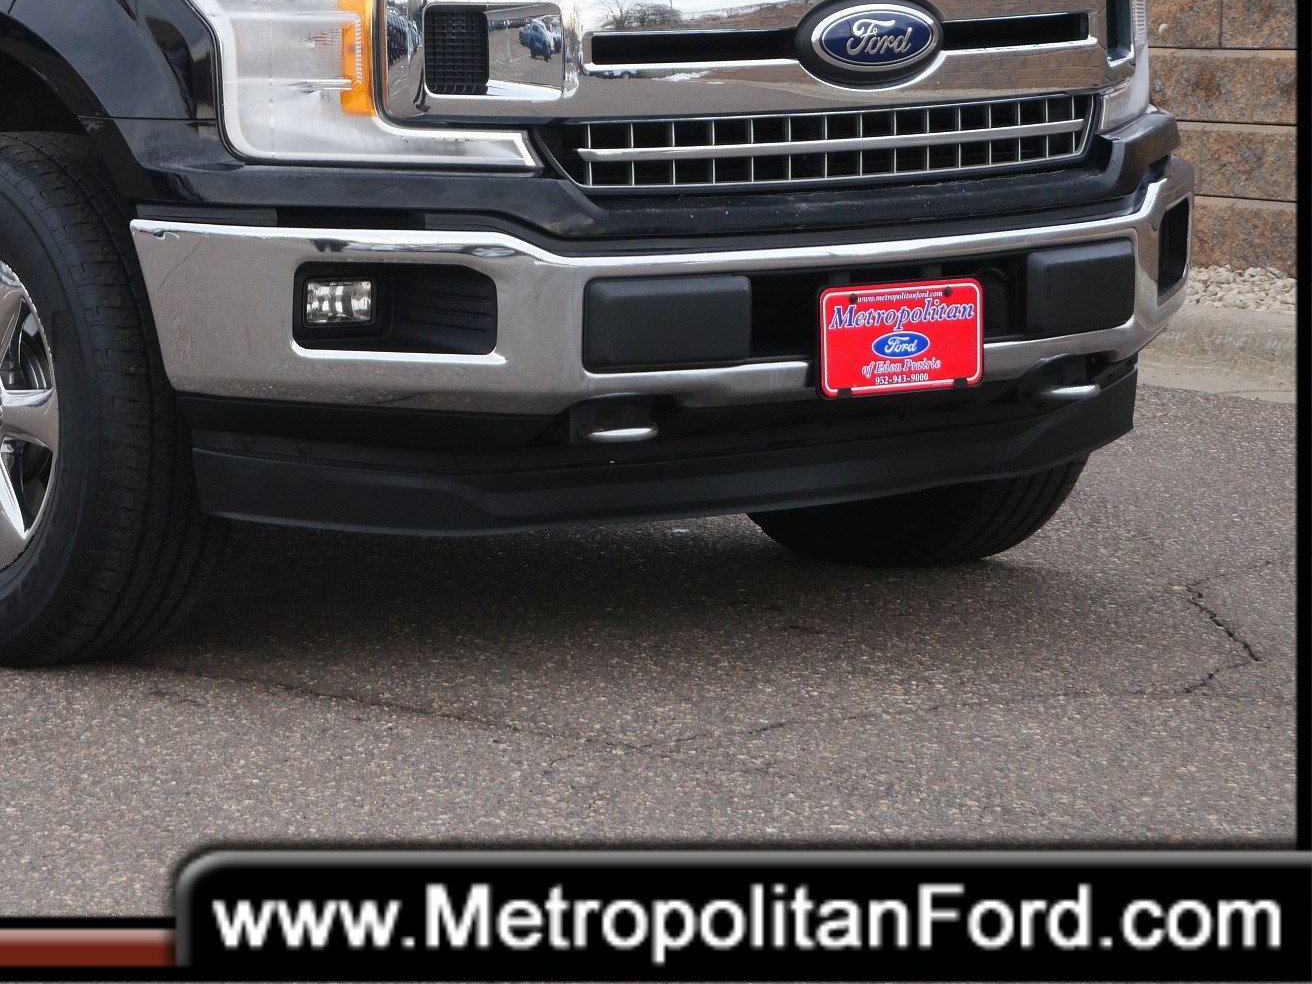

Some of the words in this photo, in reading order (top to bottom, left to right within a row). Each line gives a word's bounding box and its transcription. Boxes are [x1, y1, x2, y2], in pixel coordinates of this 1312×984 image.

[846, 18, 913, 56] Ford
[857, 290, 943, 303] www.metropolitanford.com
[828, 297, 975, 332] Metropolitan
[884, 335, 918, 353] Ford
[861, 361, 876, 378] of
[874, 360, 902, 374] Eden
[903, 357, 942, 372] Prairie
[874, 373, 929, 386] 952-943-9000
